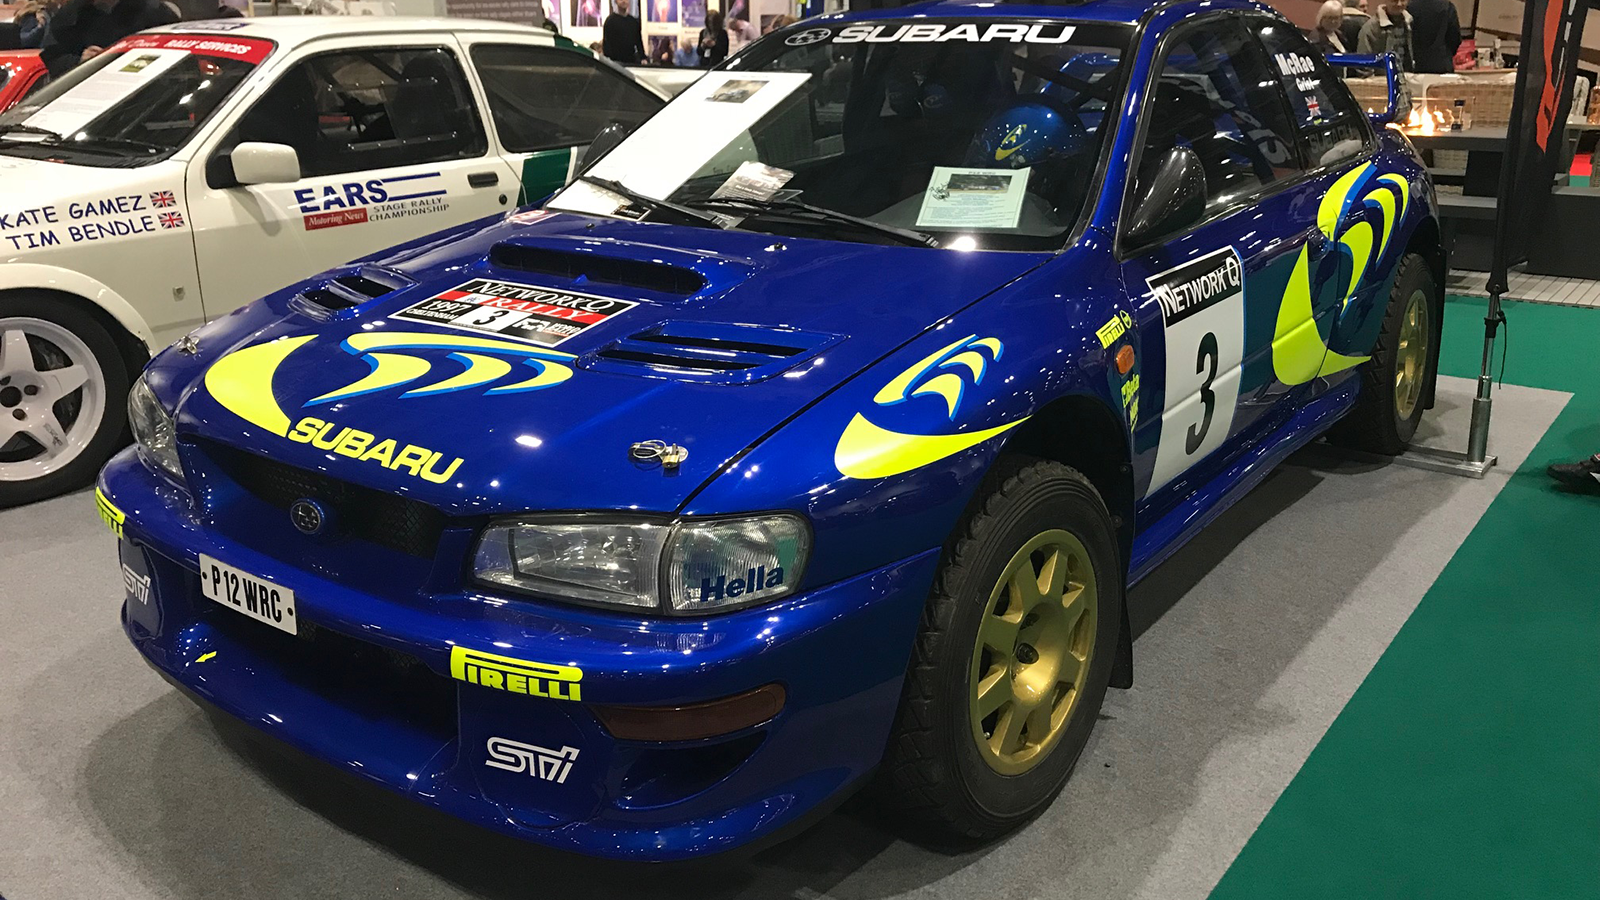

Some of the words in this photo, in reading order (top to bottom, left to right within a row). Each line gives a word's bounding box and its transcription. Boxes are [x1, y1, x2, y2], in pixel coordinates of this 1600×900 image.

[163, 39, 196, 48] RALLY
[195, 40, 252, 55] SERVICES
[832, 24, 1076, 44] SUBARU
[1274, 52, 1315, 76] McRae
[0, 206, 59, 230] KATE
[69, 195, 147, 219] GAMEZ
[294, 179, 389, 213] EARS
[369, 203, 450, 222] CHAMPIONSHIP
[373, 203, 408, 213] STAGE
[411, 197, 443, 207] RALLY
[5, 230, 61, 250] TIM
[68, 215, 156, 242] BENDLE
[309, 214, 343, 227] Motoring
[344, 212, 364, 221] News
[467, 281, 582, 308] NETWORK
[580, 299, 615, 313] Q
[1157, 267, 1228, 317] NETWORK
[1225, 256, 1240, 287] Q
[422, 300, 473, 314] 1997
[472, 310, 509, 325] 3
[488, 296, 594, 320] RALLY
[1095, 315, 1126, 349] PIRELLI
[1185, 331, 1219, 456] 3
[288, 416, 464, 484] SUBARU
[701, 564, 784, 602] Hella
[242, 577, 282, 623] WRC
[450, 645, 583, 701] PIRELLI
